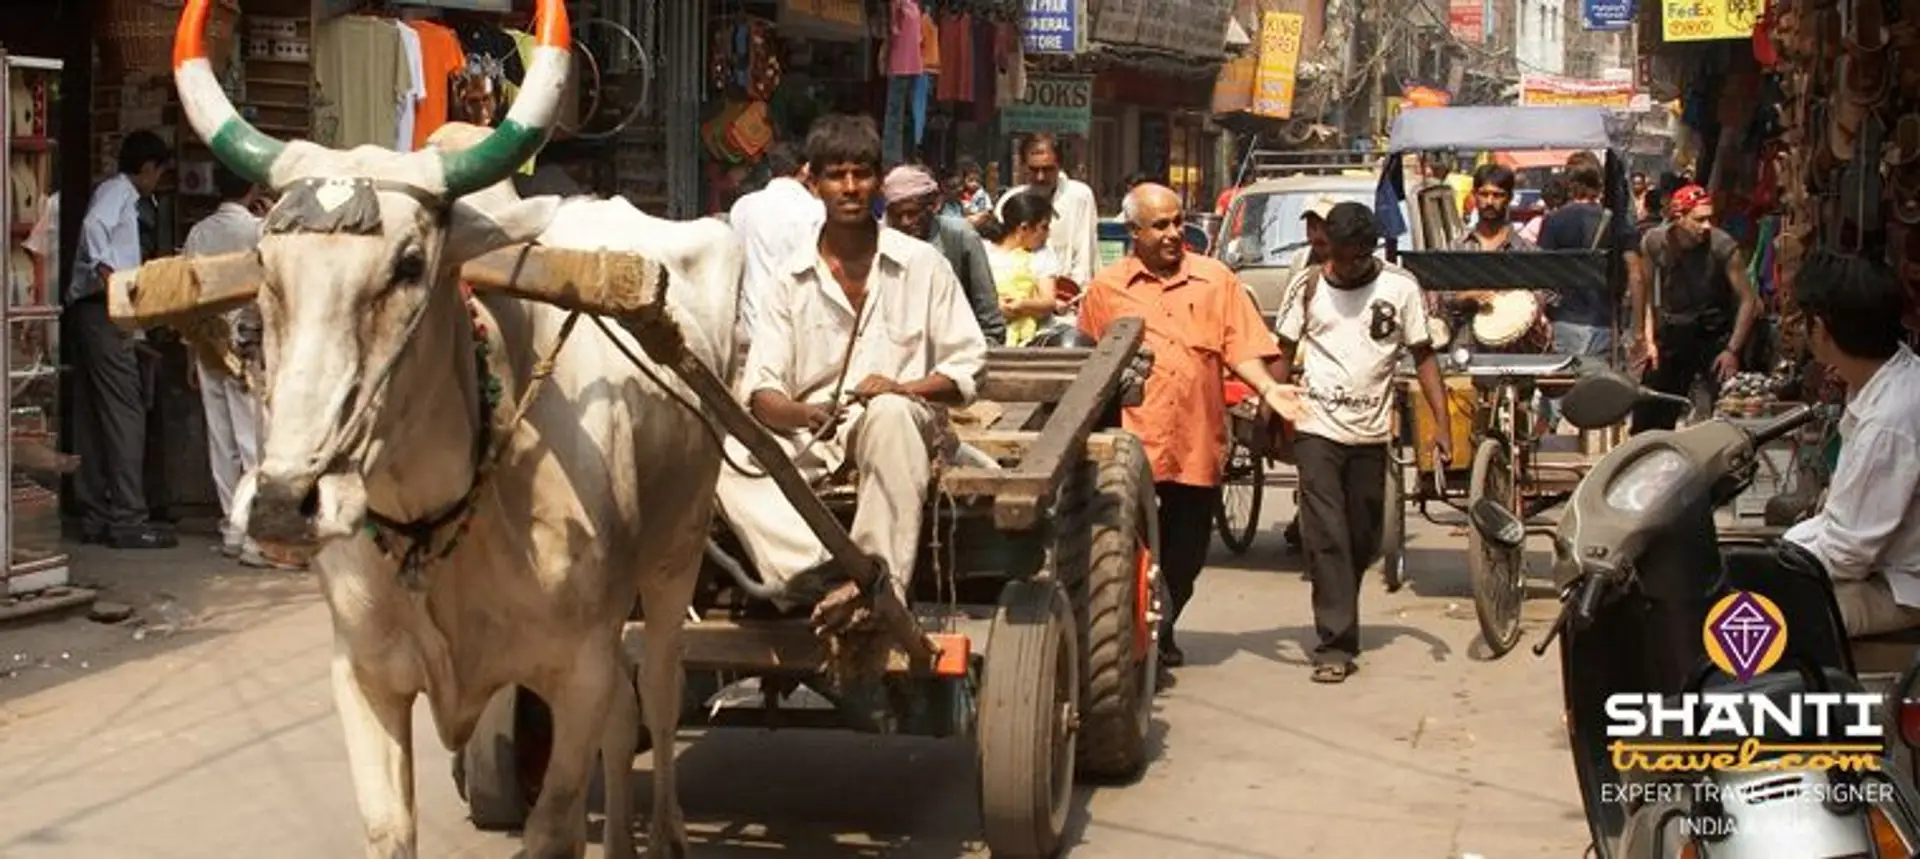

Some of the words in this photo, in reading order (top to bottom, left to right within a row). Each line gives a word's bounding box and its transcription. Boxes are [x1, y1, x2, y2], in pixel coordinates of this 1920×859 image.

[1668, 2, 1716, 18] FedEx
[1019, 17, 1071, 32] ENERAL
[1013, 82, 1088, 107] OOKS
[1369, 298, 1397, 340] B
